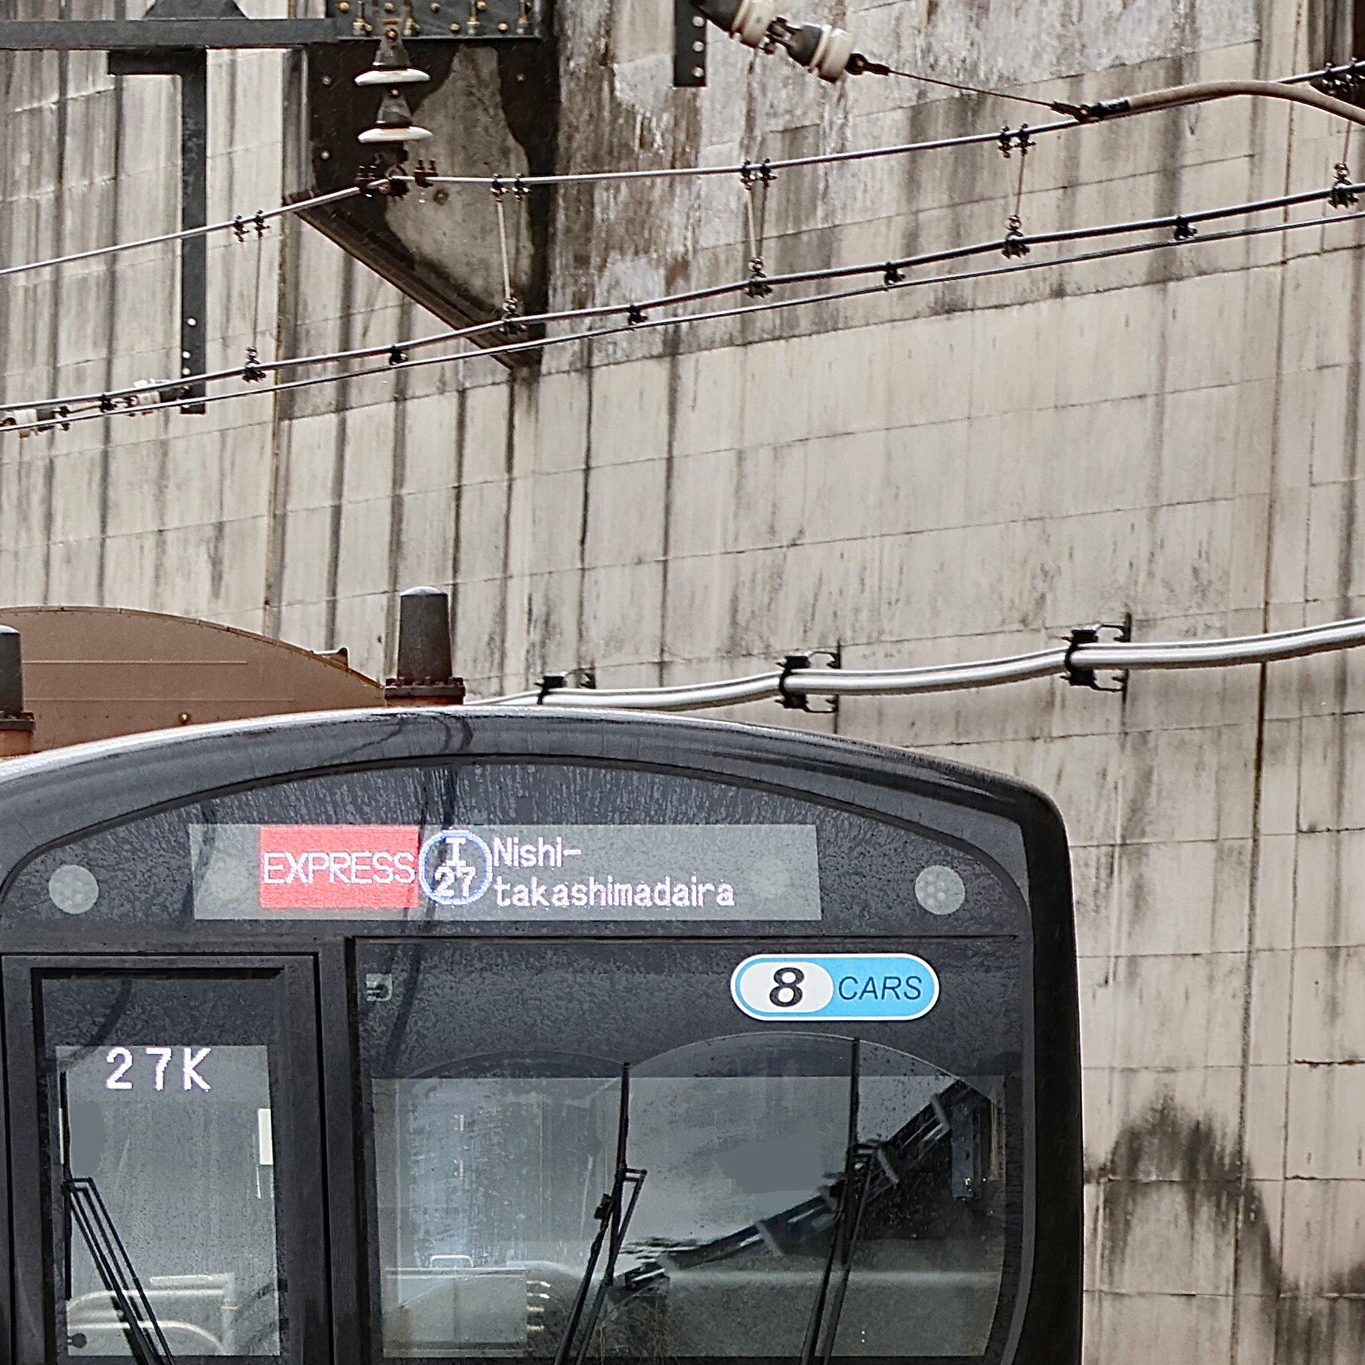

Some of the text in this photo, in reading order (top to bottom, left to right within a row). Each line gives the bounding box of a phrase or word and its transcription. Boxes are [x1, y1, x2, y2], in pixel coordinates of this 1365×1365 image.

[262, 851, 417, 885] EXPRESS
[493, 836, 582, 868] Nishi-
[434, 866, 477, 898] 27
[493, 875, 736, 908] takashimadaira
[769, 966, 923, 1008] 8 CARS
[106, 1046, 213, 1092] 27K
